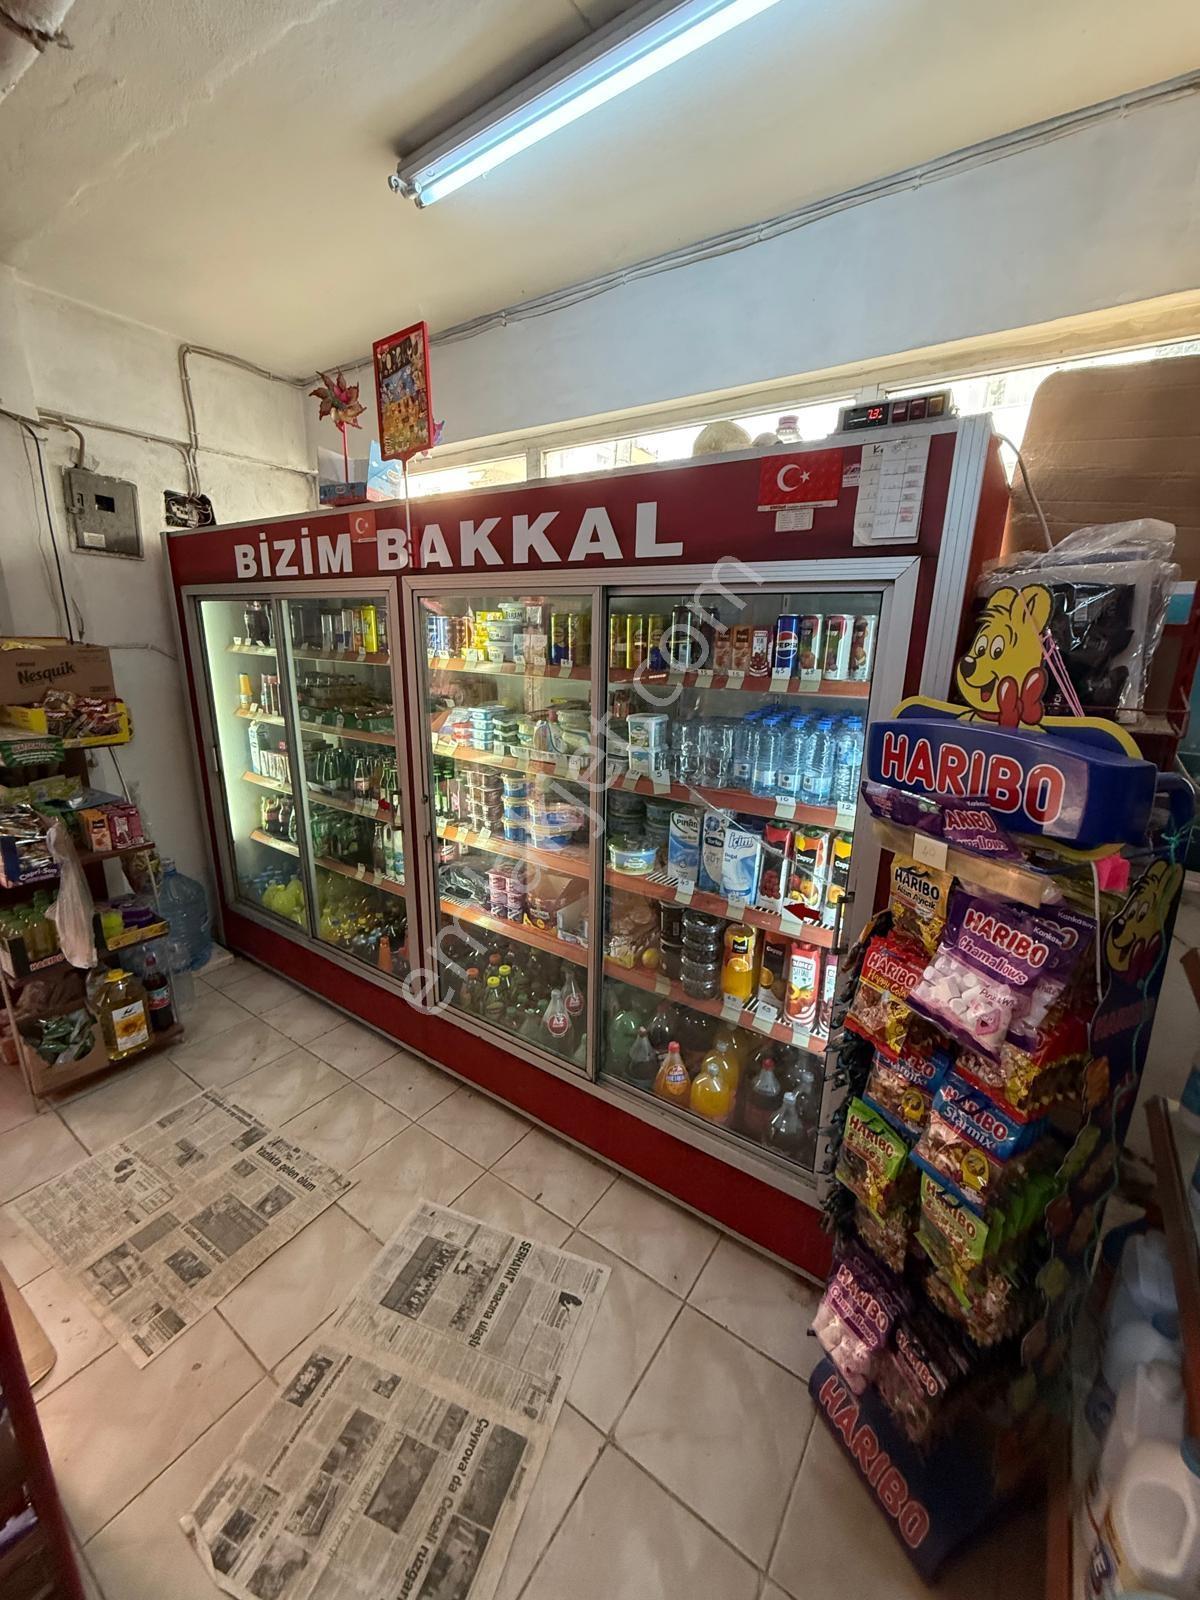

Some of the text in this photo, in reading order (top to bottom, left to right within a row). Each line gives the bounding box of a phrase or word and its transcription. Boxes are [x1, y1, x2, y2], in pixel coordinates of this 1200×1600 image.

[234, 501, 684, 579] BİZİM BAKKAL
[17, 661, 76, 684] Nesquik
[881, 731, 1066, 825] HARIBO
[944, 809, 997, 832] ARIBO
[894, 868, 940, 901] HARIBO
[958, 935, 1029, 986] Chamallows
[963, 908, 1049, 969] HARIBO
[866, 951, 919, 991] HARIBO
[849, 1113, 896, 1160] HARIBO
[944, 1106, 993, 1150] Starmix
[509, 1240, 533, 1284] SERHAYAT
[448, 1417, 490, 1495] Çayırova'da
[818, 1374, 930, 1549] HARIBO
[396, 1544, 430, 1600] rüzgar
